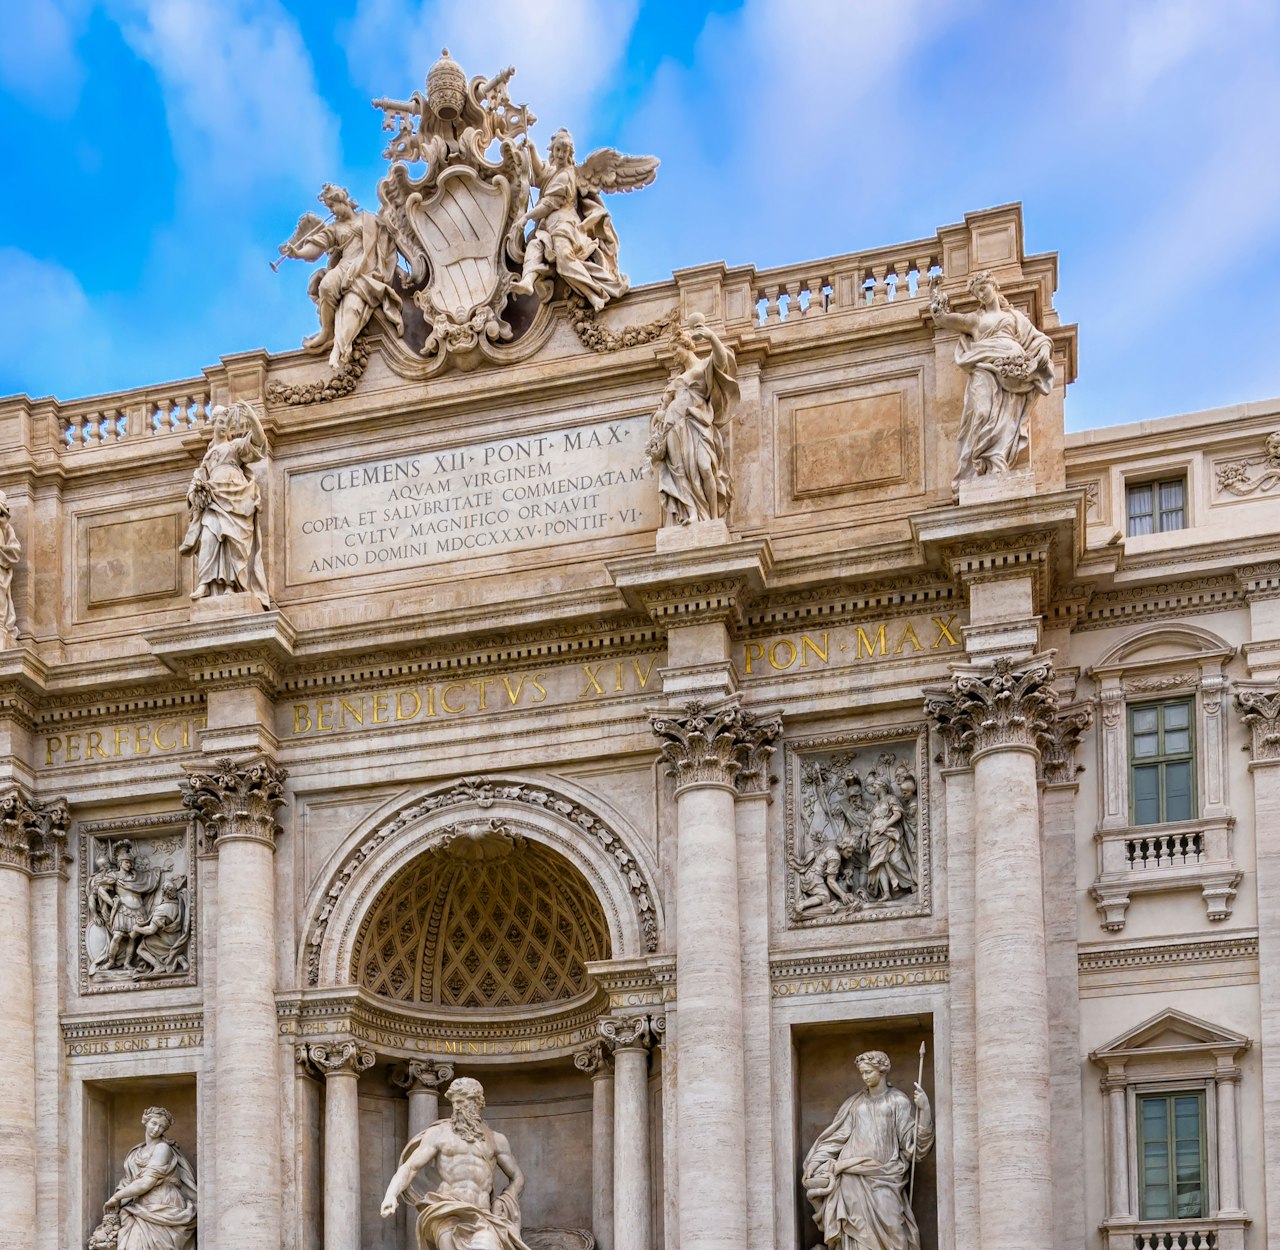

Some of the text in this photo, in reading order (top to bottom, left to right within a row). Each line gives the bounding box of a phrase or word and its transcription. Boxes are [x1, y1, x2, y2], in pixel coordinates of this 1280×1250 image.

[320, 425, 623, 492] CLEMENS XII PONT MAX
[387, 462, 552, 502] AQVAM VIRGINEM
[302, 466, 644, 535] COPIA ET SALVBRITATE COMMENDATAM
[344, 494, 600, 548] CVLTV MAGNIFICO ORNAVIT
[308, 553, 359, 573] ANNO
[365, 542, 428, 565] DOMINI
[742, 613, 961, 676] PON MAX
[292, 653, 658, 734] BENEDICTVS XIV
[772, 979, 833, 997] SOLVTVM
[68, 1041, 109, 1056] POSITIS
[114, 1038, 150, 1052] SIGNIS
[157, 1036, 171, 1049] ET
[375, 1030, 407, 1047] IVSSV
